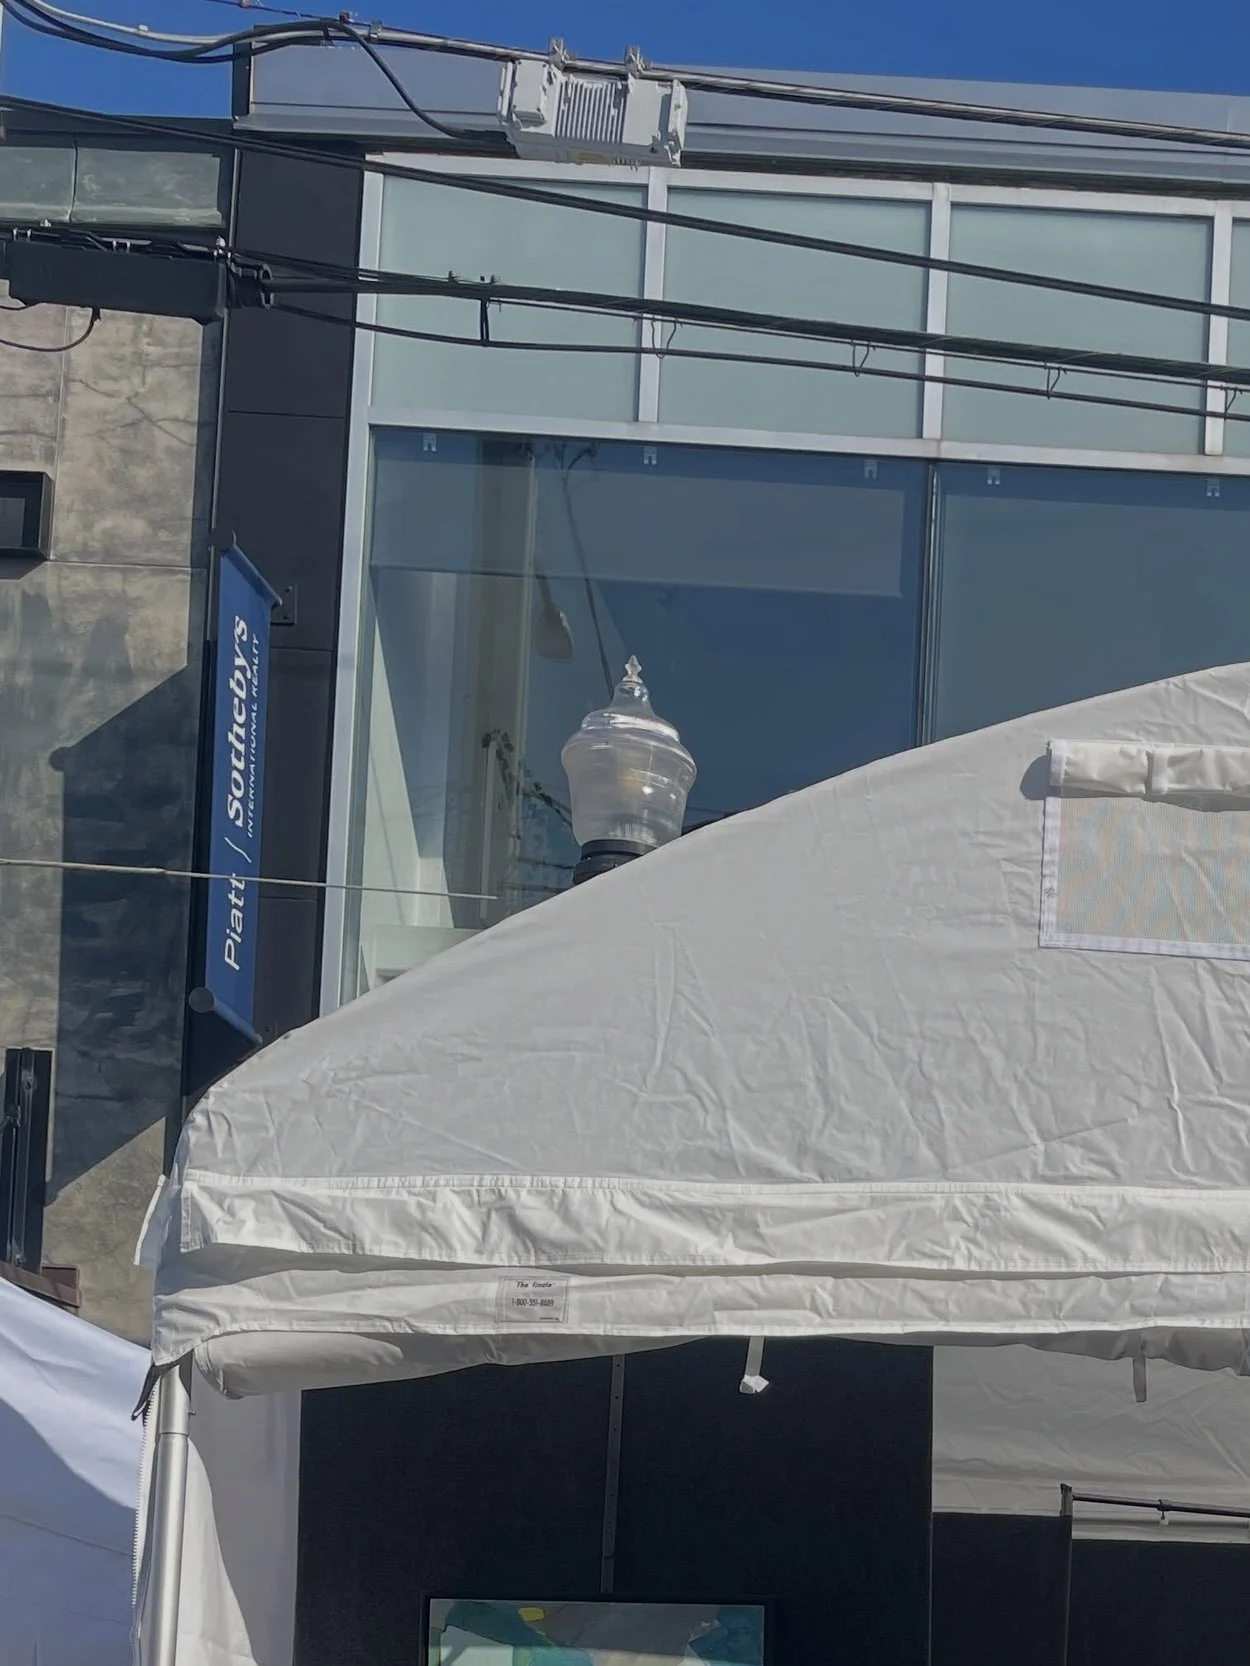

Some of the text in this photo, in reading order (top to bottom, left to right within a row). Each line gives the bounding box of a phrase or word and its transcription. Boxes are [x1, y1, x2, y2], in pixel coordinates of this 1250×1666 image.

[224, 615, 252, 971] Piatt Sotheby's
[247, 632, 261, 838] INTERNATIONAL REALTY
